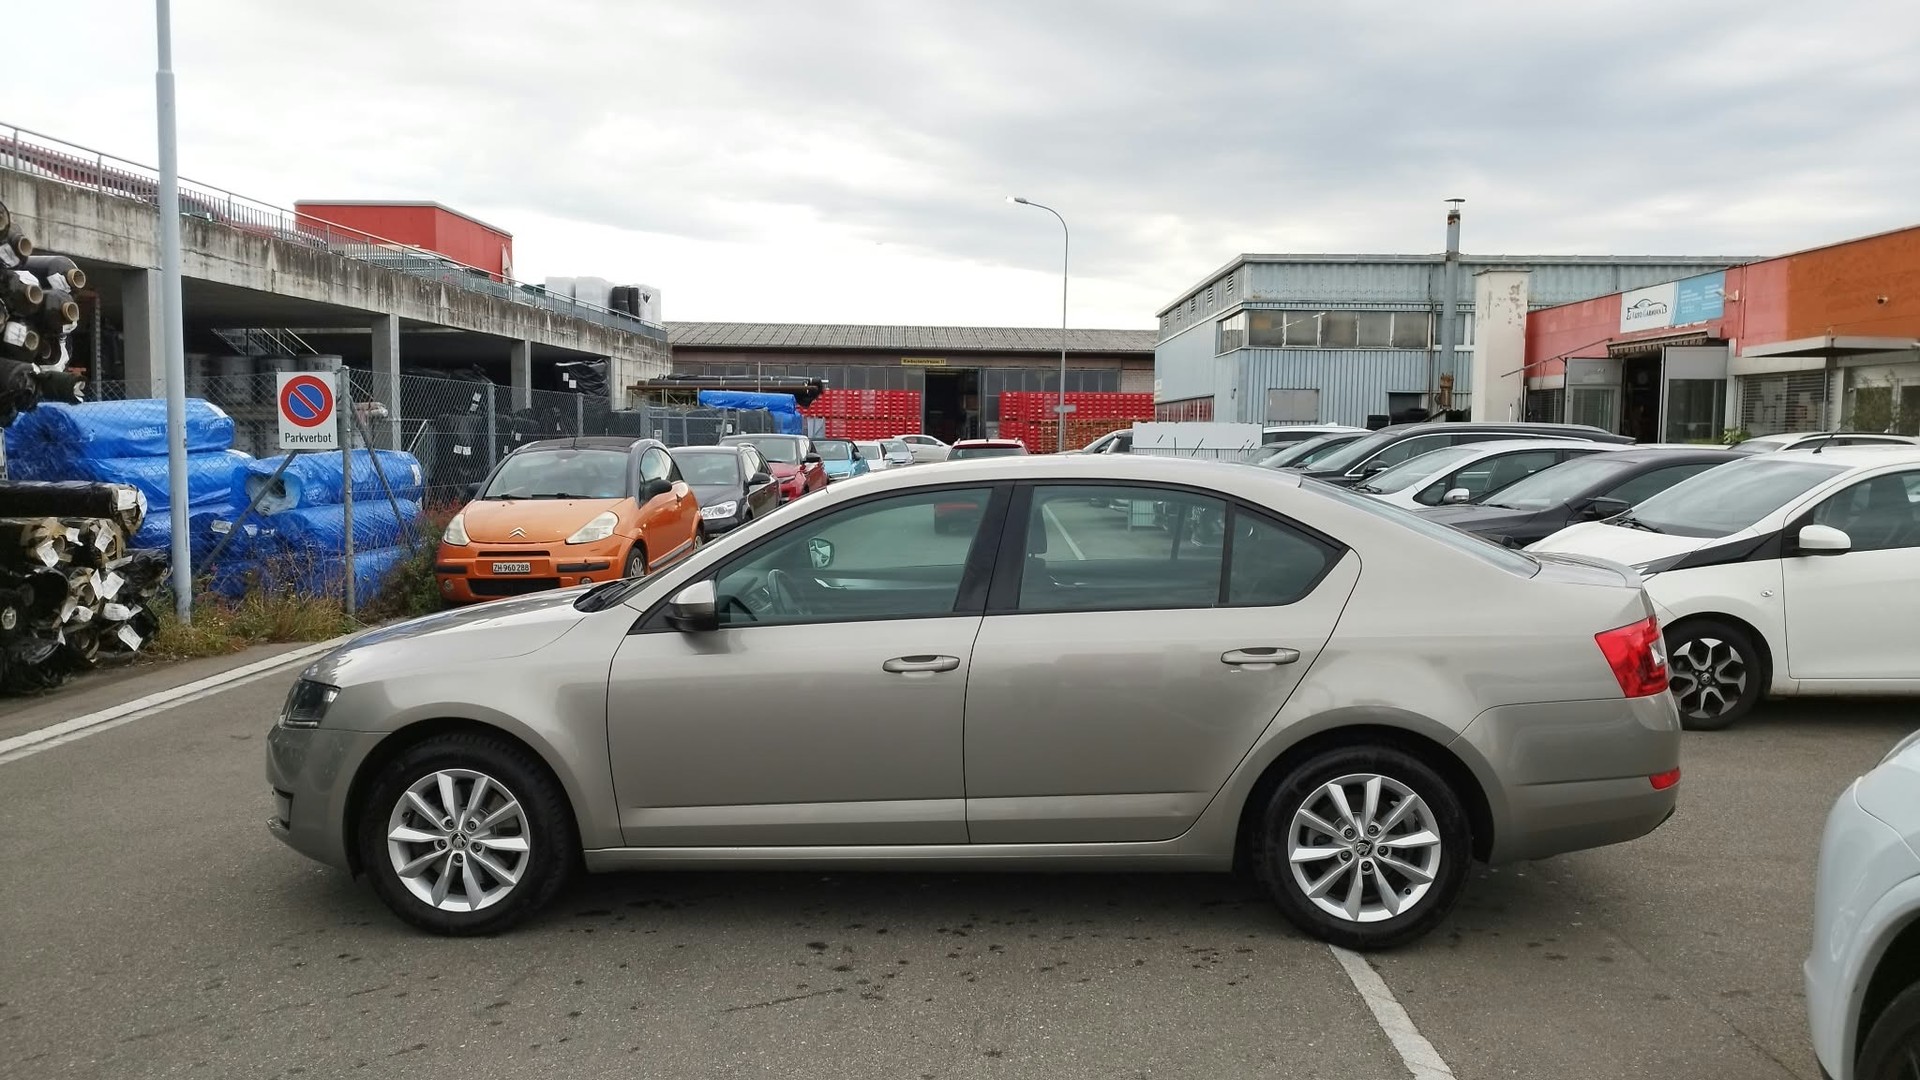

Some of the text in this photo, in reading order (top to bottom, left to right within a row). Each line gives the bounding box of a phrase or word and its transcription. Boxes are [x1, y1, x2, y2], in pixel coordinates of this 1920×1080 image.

[284, 432, 332, 443] Parkverbot
[494, 564, 530, 572] ZH 960 288
